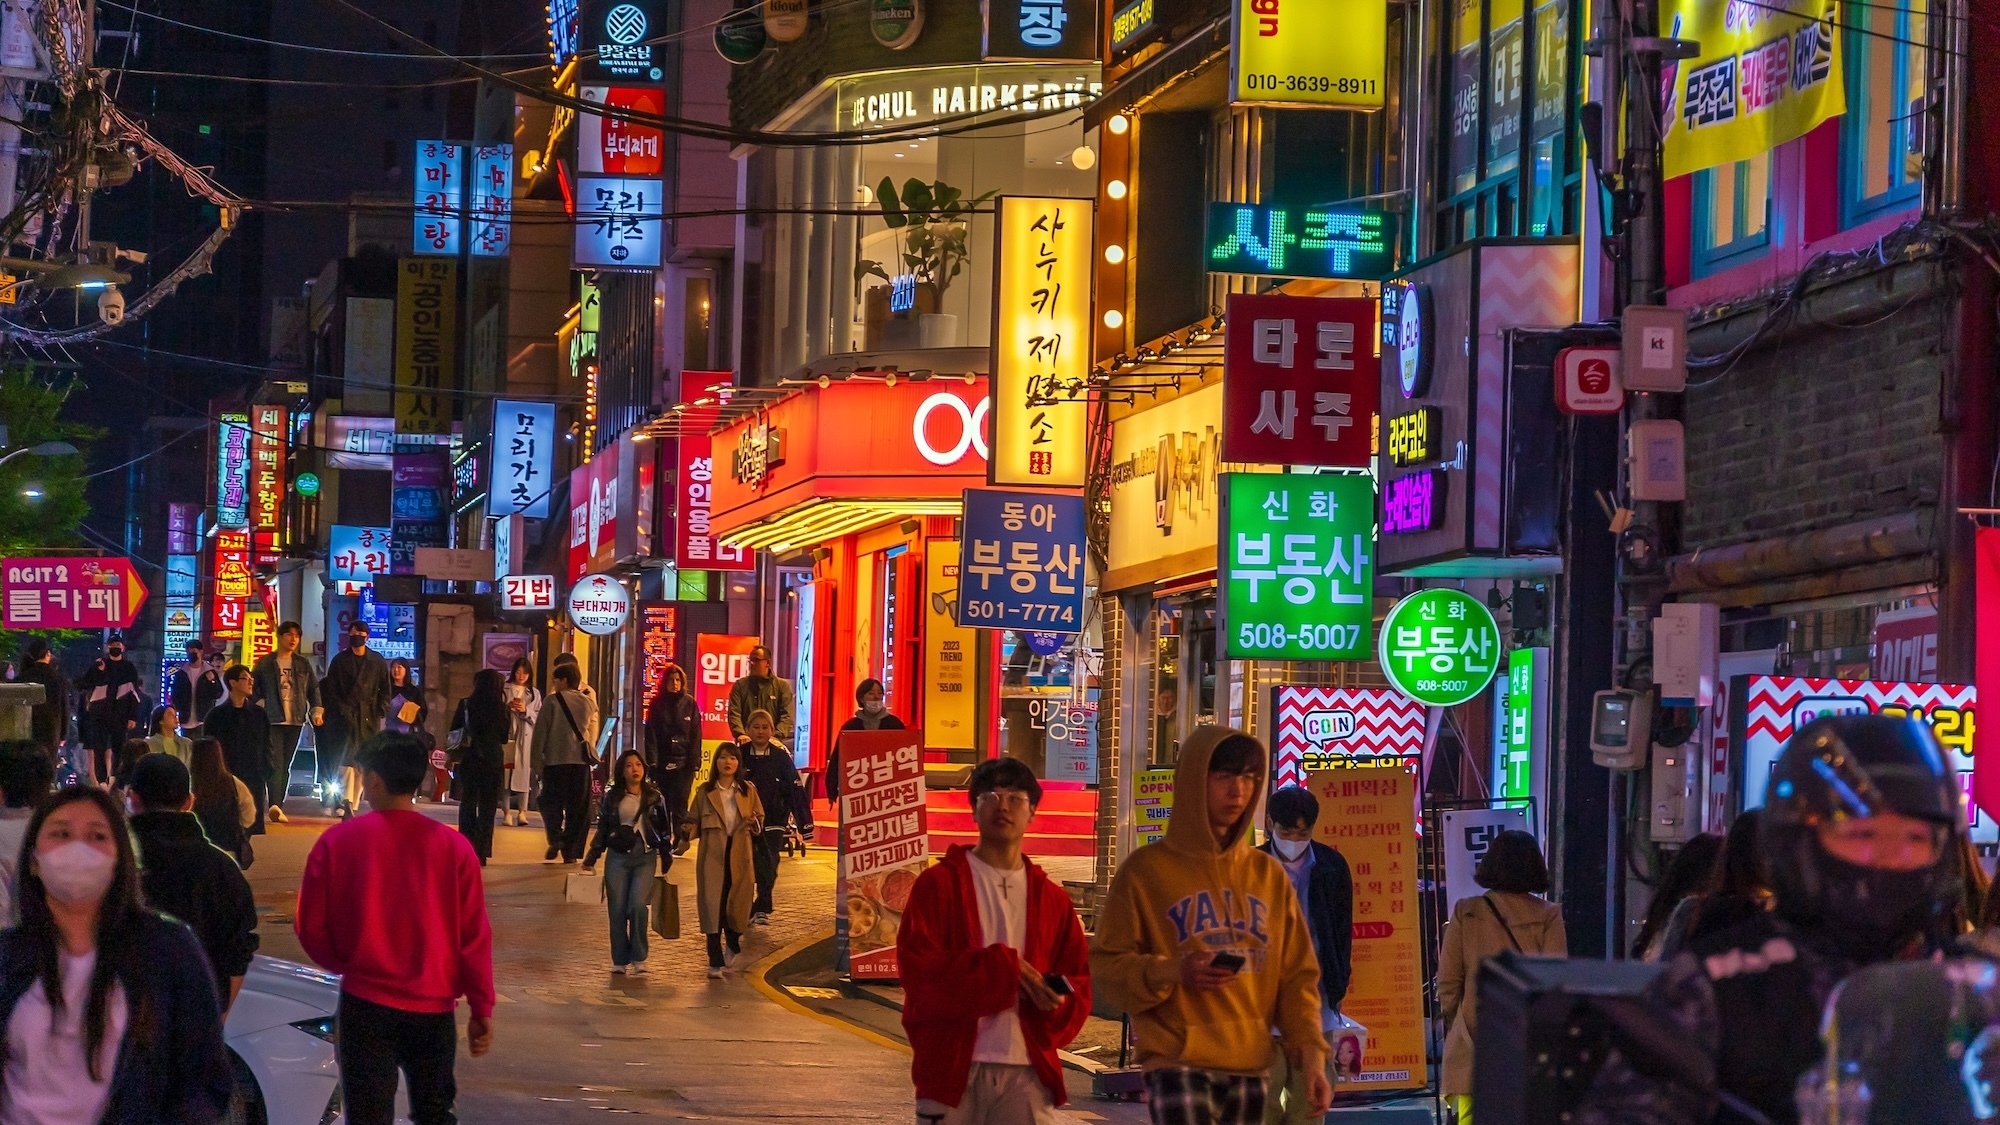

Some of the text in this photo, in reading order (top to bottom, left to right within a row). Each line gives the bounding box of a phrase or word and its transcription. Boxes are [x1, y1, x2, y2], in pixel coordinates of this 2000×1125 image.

[1018, 0, 1068, 48] 장
[1248, 74, 1376, 95] 010-3639-8911
[1684, 57, 1736, 131] 무조건
[852, 96, 866, 127] LEE
[867, 90, 917, 122] CHUL
[422, 143, 455, 158] 중경
[604, 133, 658, 158] 부대찌개
[424, 162, 451, 250] 마라탕
[595, 187, 643, 212] 모리
[594, 212, 644, 240] 가츠
[1211, 208, 1384, 272] 사주
[611, 248, 628, 258] 지하
[1026, 207, 1066, 445] 사누키제면소
[1401, 318, 1419, 351] LALA
[409, 282, 443, 418] 공인중개사
[1251, 317, 1356, 370] 타로
[1651, 338, 1665, 350] kt
[1249, 390, 1354, 442] 사주
[1388, 408, 1428, 464] 라라코인
[258, 410, 279, 528] 세계맥주창고
[508, 412, 539, 506] 모리가츠
[687, 457, 713, 560] 성인용품
[1000, 501, 1057, 533] 동아
[1261, 490, 1339, 522] 신화
[9, 565, 69, 583] AGIT 2
[968, 539, 1082, 595] 부동산
[1231, 532, 1369, 605] 부동산
[220, 581, 246, 590] TOUCH
[490, 578, 552, 606] 김밥
[9, 589, 120, 622] 룸카페
[571, 599, 626, 613] 부대찌개
[579, 616, 619, 627] 철판구이
[967, 600, 1074, 625] 501-7774
[1418, 600, 1468, 621] 신화
[942, 641, 961, 651] 2023
[1239, 622, 1361, 651] 508-5007
[1392, 625, 1493, 673] 부동산
[939, 651, 963, 662] TREND
[1416, 679, 1469, 691] 508-5007
[714, 699, 730, 711] 5
[1308, 716, 1350, 735] COIN
[846, 744, 919, 790] 강남역
[849, 781, 919, 819] 피자맛집
[1140, 783, 1173, 794] OPEN
[1322, 778, 1398, 798] 슈퍼왁싱
[849, 811, 920, 849] 오리지널
[1323, 822, 1401, 838] 브라질리언
[850, 838, 924, 875] 시카고피자
[1167, 889, 1269, 943] YALE
